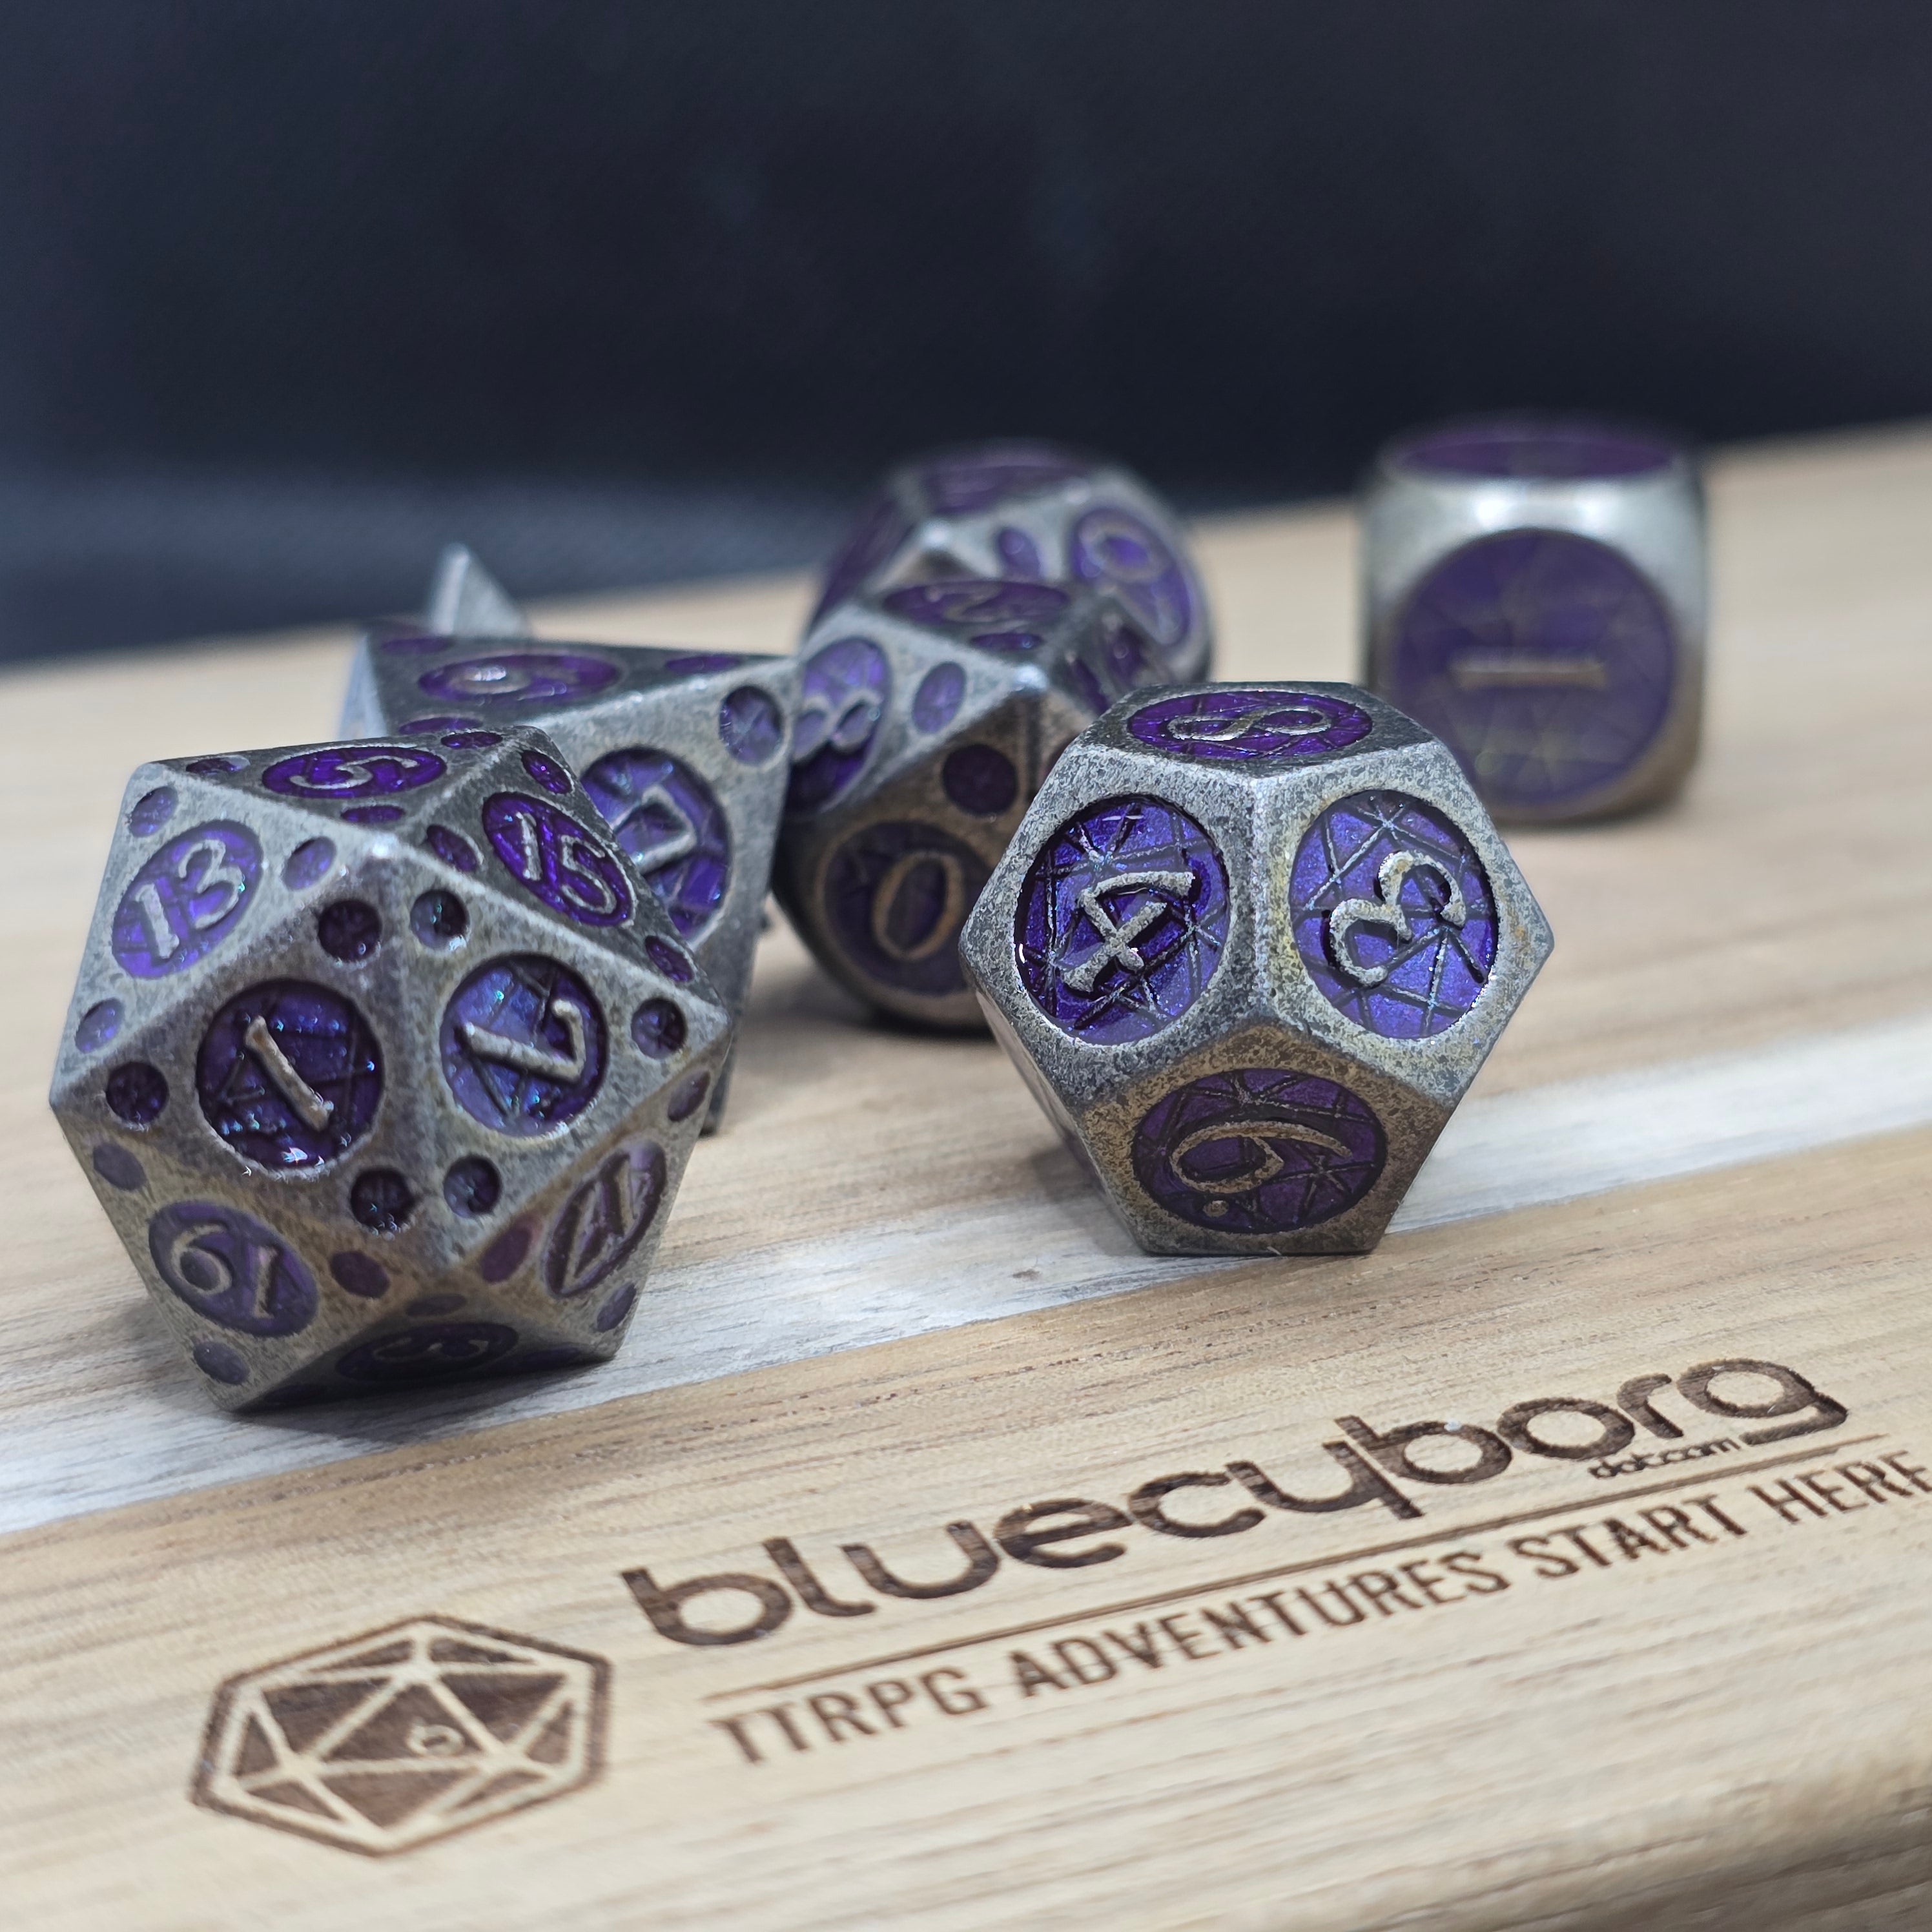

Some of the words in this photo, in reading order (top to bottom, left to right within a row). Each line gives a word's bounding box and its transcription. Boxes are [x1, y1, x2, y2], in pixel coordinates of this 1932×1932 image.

[289, 754, 418, 792] 5
[1167, 704, 1332, 742] 8
[135, 838, 244, 959] 13
[517, 812, 617, 914] 15
[872, 847, 965, 963] 0
[1330, 849, 1468, 988] 3
[1060, 869, 1197, 993] 4
[243, 1012, 335, 1131] 1
[618, 1358, 1849, 1647] bluecyborg
[1587, 1436, 1742, 1480] dotcom
[711, 1664, 989, 1765] TTRPG
[1007, 1551, 1511, 1698] ADVENTURES
[1508, 1493, 1749, 1579] START
[1746, 1450, 1932, 1525] HERE
